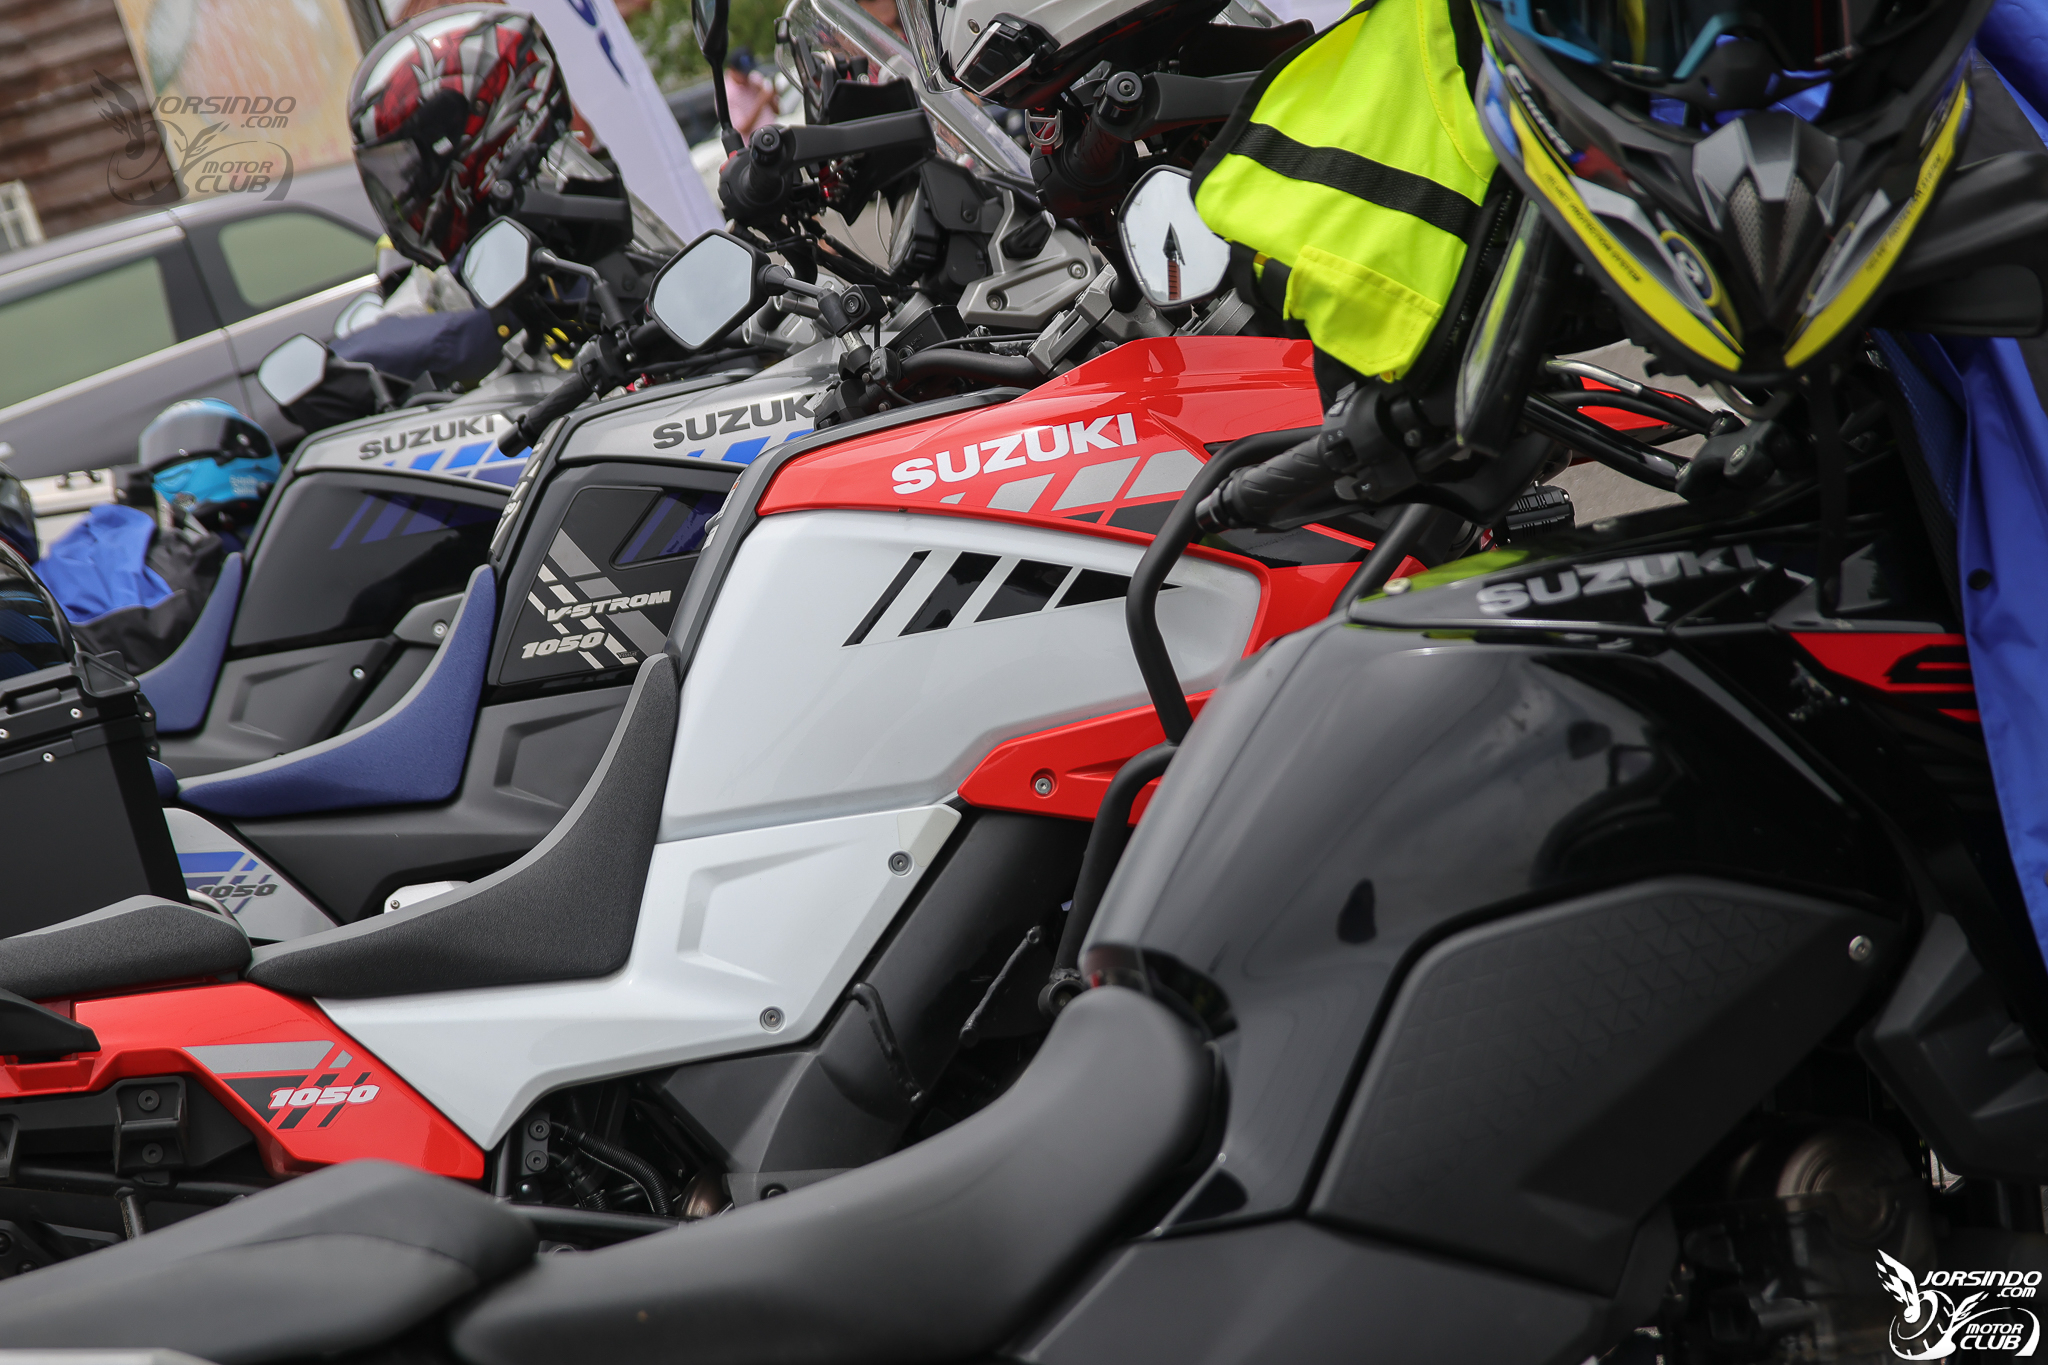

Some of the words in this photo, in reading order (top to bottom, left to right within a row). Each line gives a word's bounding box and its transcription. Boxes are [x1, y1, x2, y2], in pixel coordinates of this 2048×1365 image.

[358, 414, 496, 461] SUZUKI
[652, 392, 818, 450] SUZUK
[890, 412, 1138, 495] SUZUKI
[1475, 543, 1761, 616] SUZUKI
[546, 589, 672, 622] V-STROM
[521, 631, 605, 660] 1050
[268, 1084, 381, 1110] 1050
